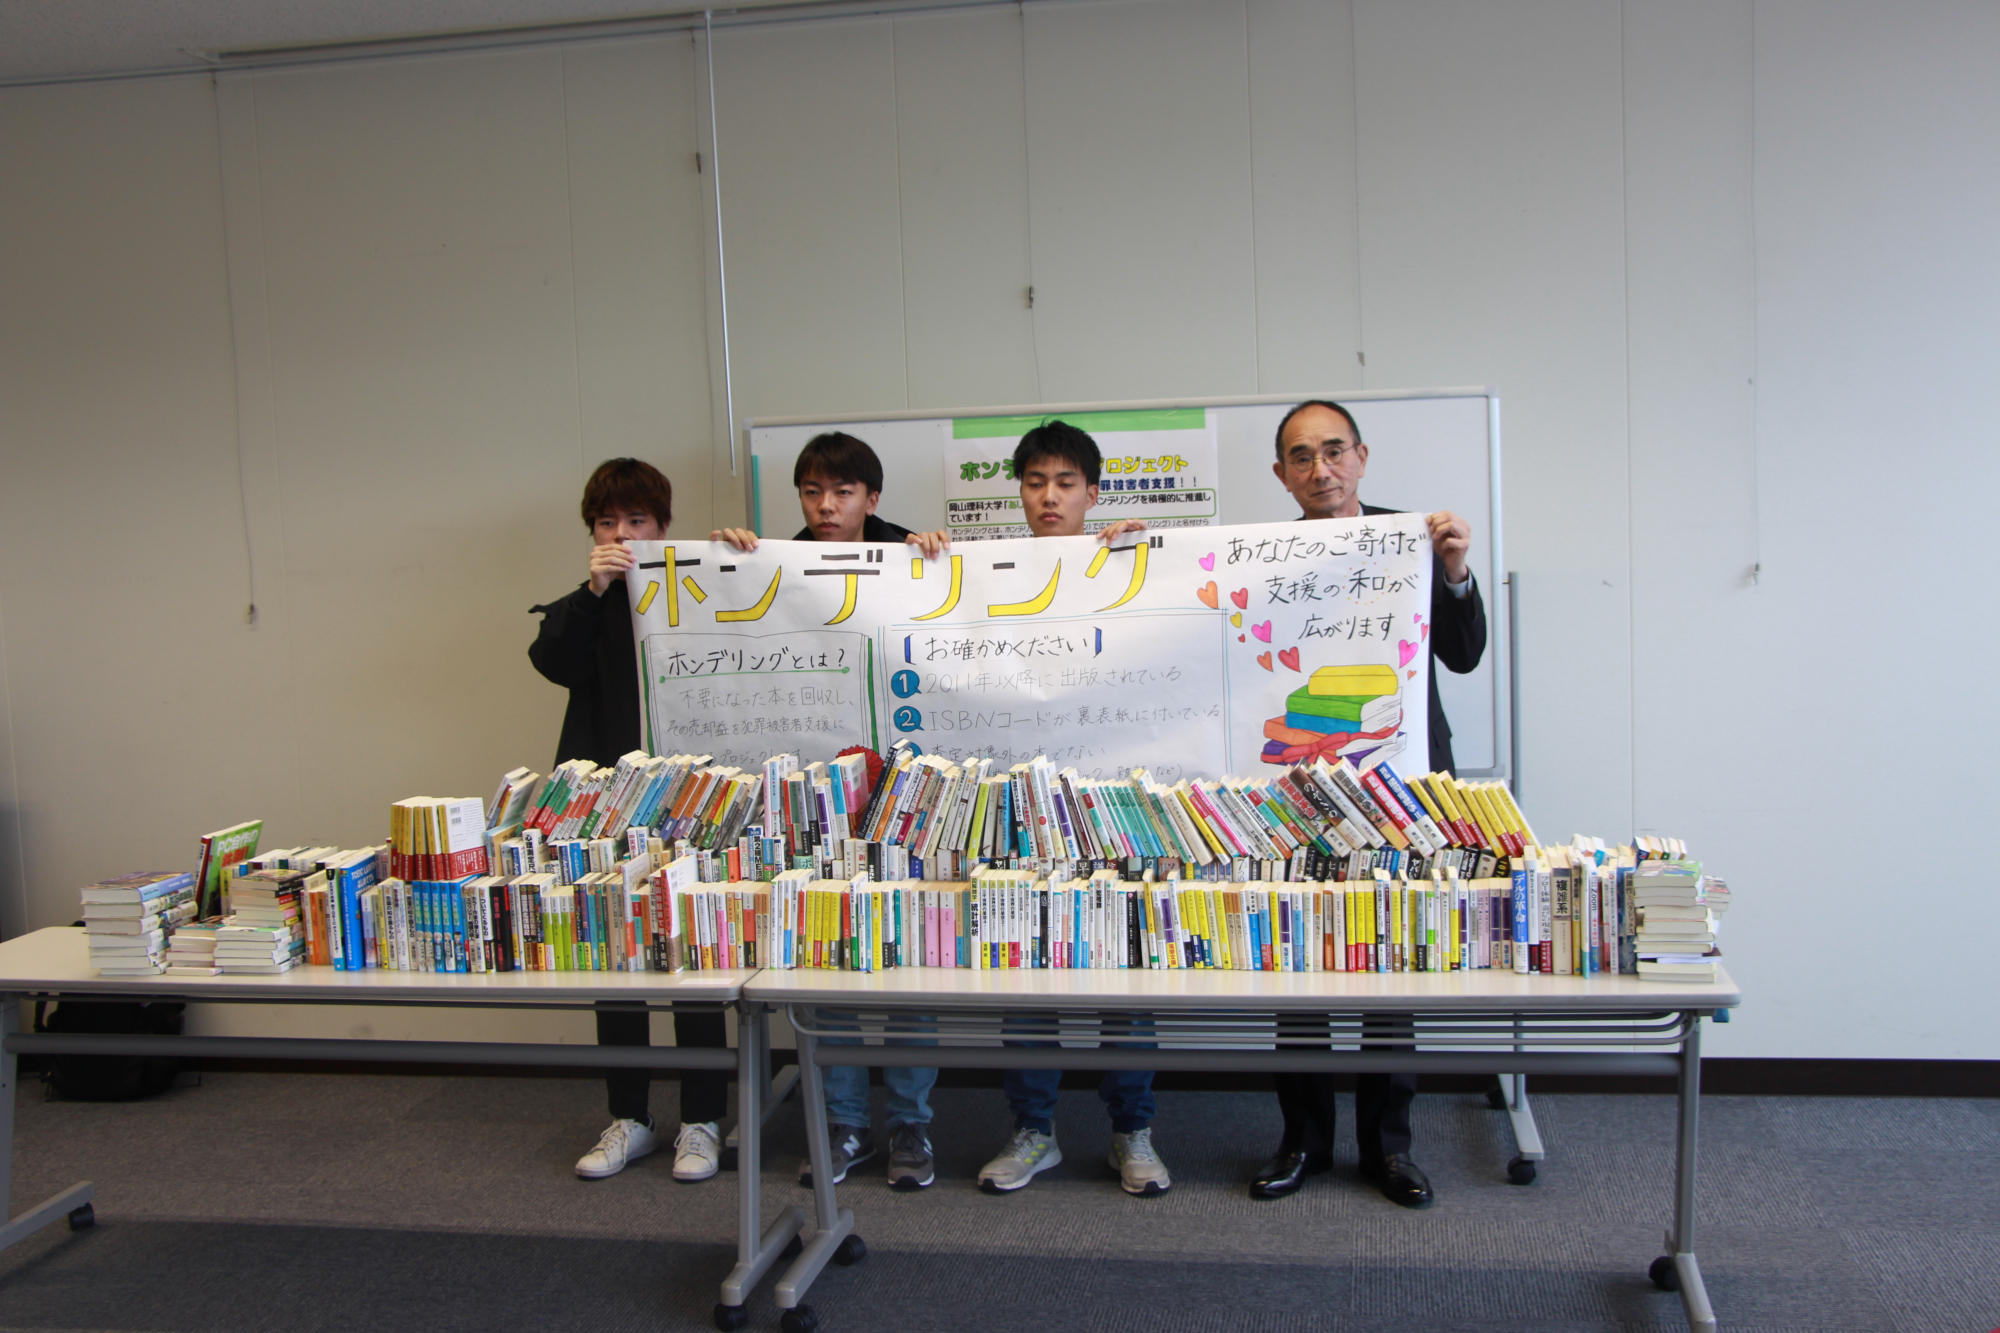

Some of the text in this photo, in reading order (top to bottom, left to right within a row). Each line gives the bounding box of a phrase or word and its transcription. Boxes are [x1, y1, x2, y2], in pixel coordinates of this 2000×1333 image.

[1100, 455, 1188, 473] ロジェクト
[1227, 528, 1427, 565] あなたのご寄付で
[636, 534, 1163, 627] ホンデリング
[1265, 569, 1420, 605] 支援の和が
[1298, 613, 1396, 641] 広がります
[926, 665, 1182, 695] 2011年以降に出版されている
[666, 715, 845, 738] その売却益を犯罪被害者支援に
[929, 703, 1220, 732] ISBNコードが裏表紙に付いている
[1513, 873, 1526, 923] デルの革命
[1556, 880, 1568, 914] 複雑系
